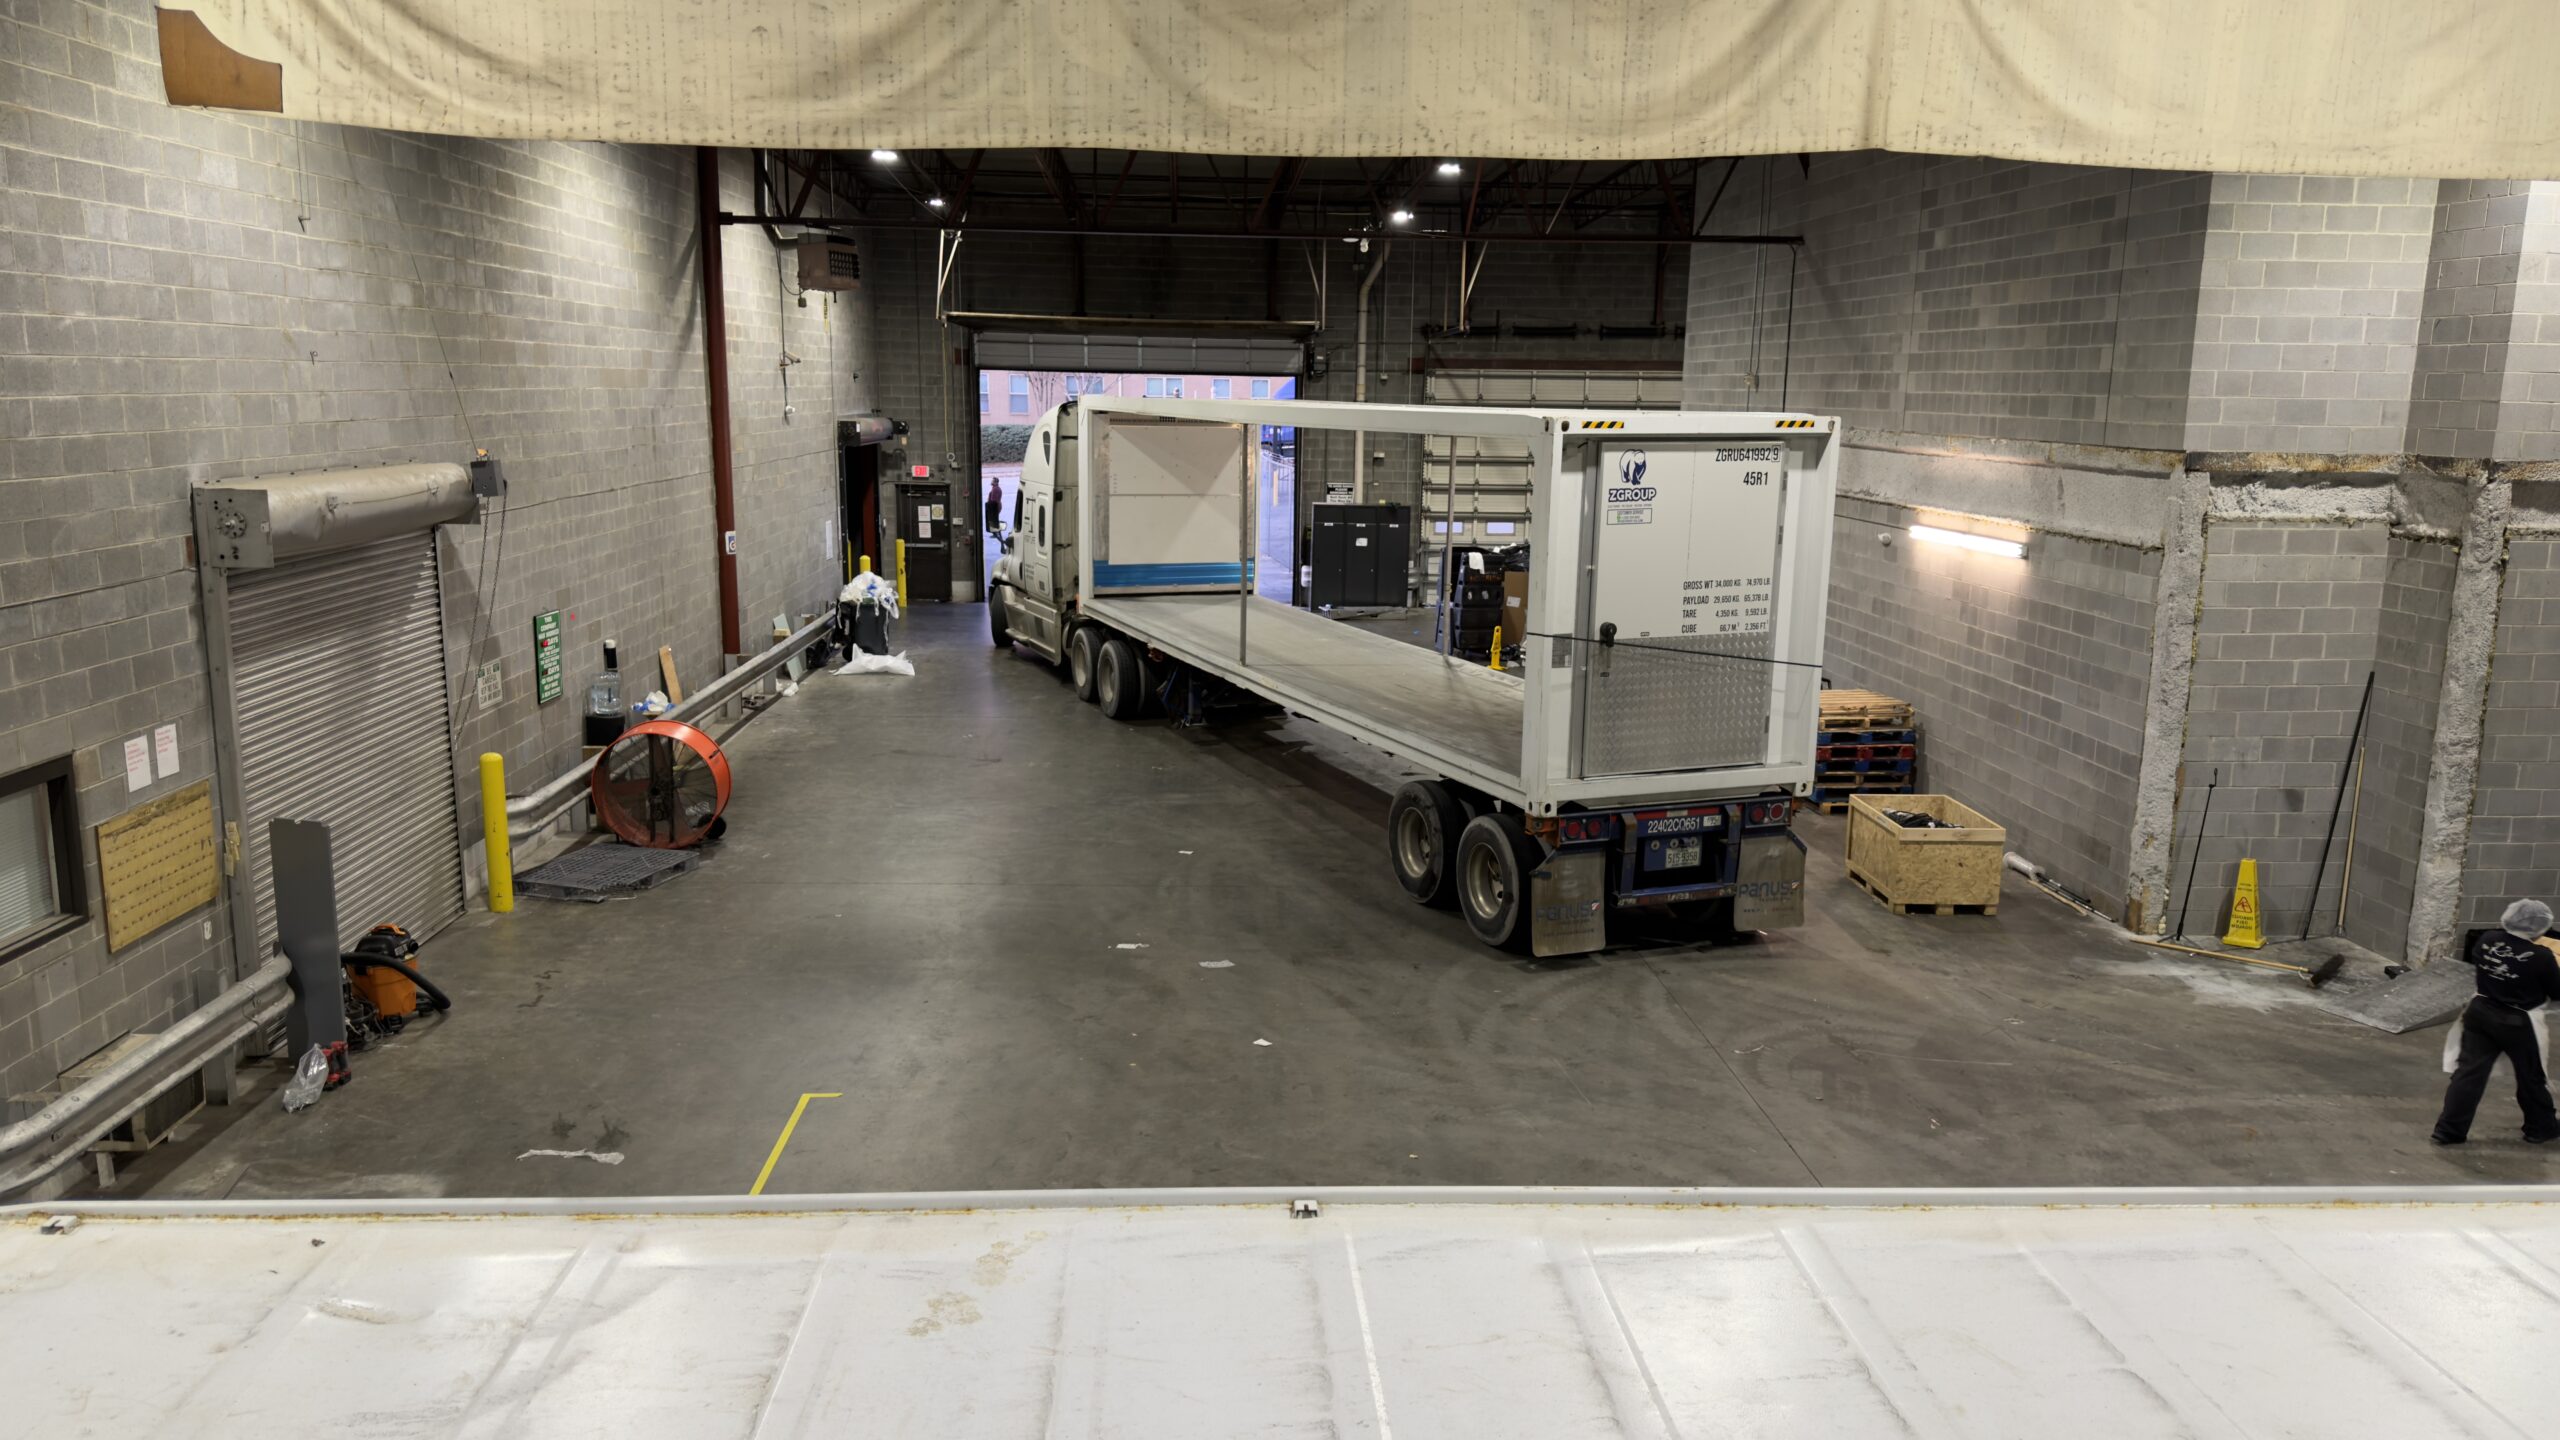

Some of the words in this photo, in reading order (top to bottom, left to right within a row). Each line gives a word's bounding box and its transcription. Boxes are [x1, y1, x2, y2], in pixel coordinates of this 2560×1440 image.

[1743, 471, 1769, 486] 45R1
[1608, 487, 1657, 502] ZGROUP
[1683, 580, 1703, 590] GROSS
[1704, 579, 1714, 589] WT
[1683, 595, 1709, 605] PAYLOAD
[1682, 609, 1697, 618] TARE
[1682, 624, 1697, 633] CUBE
